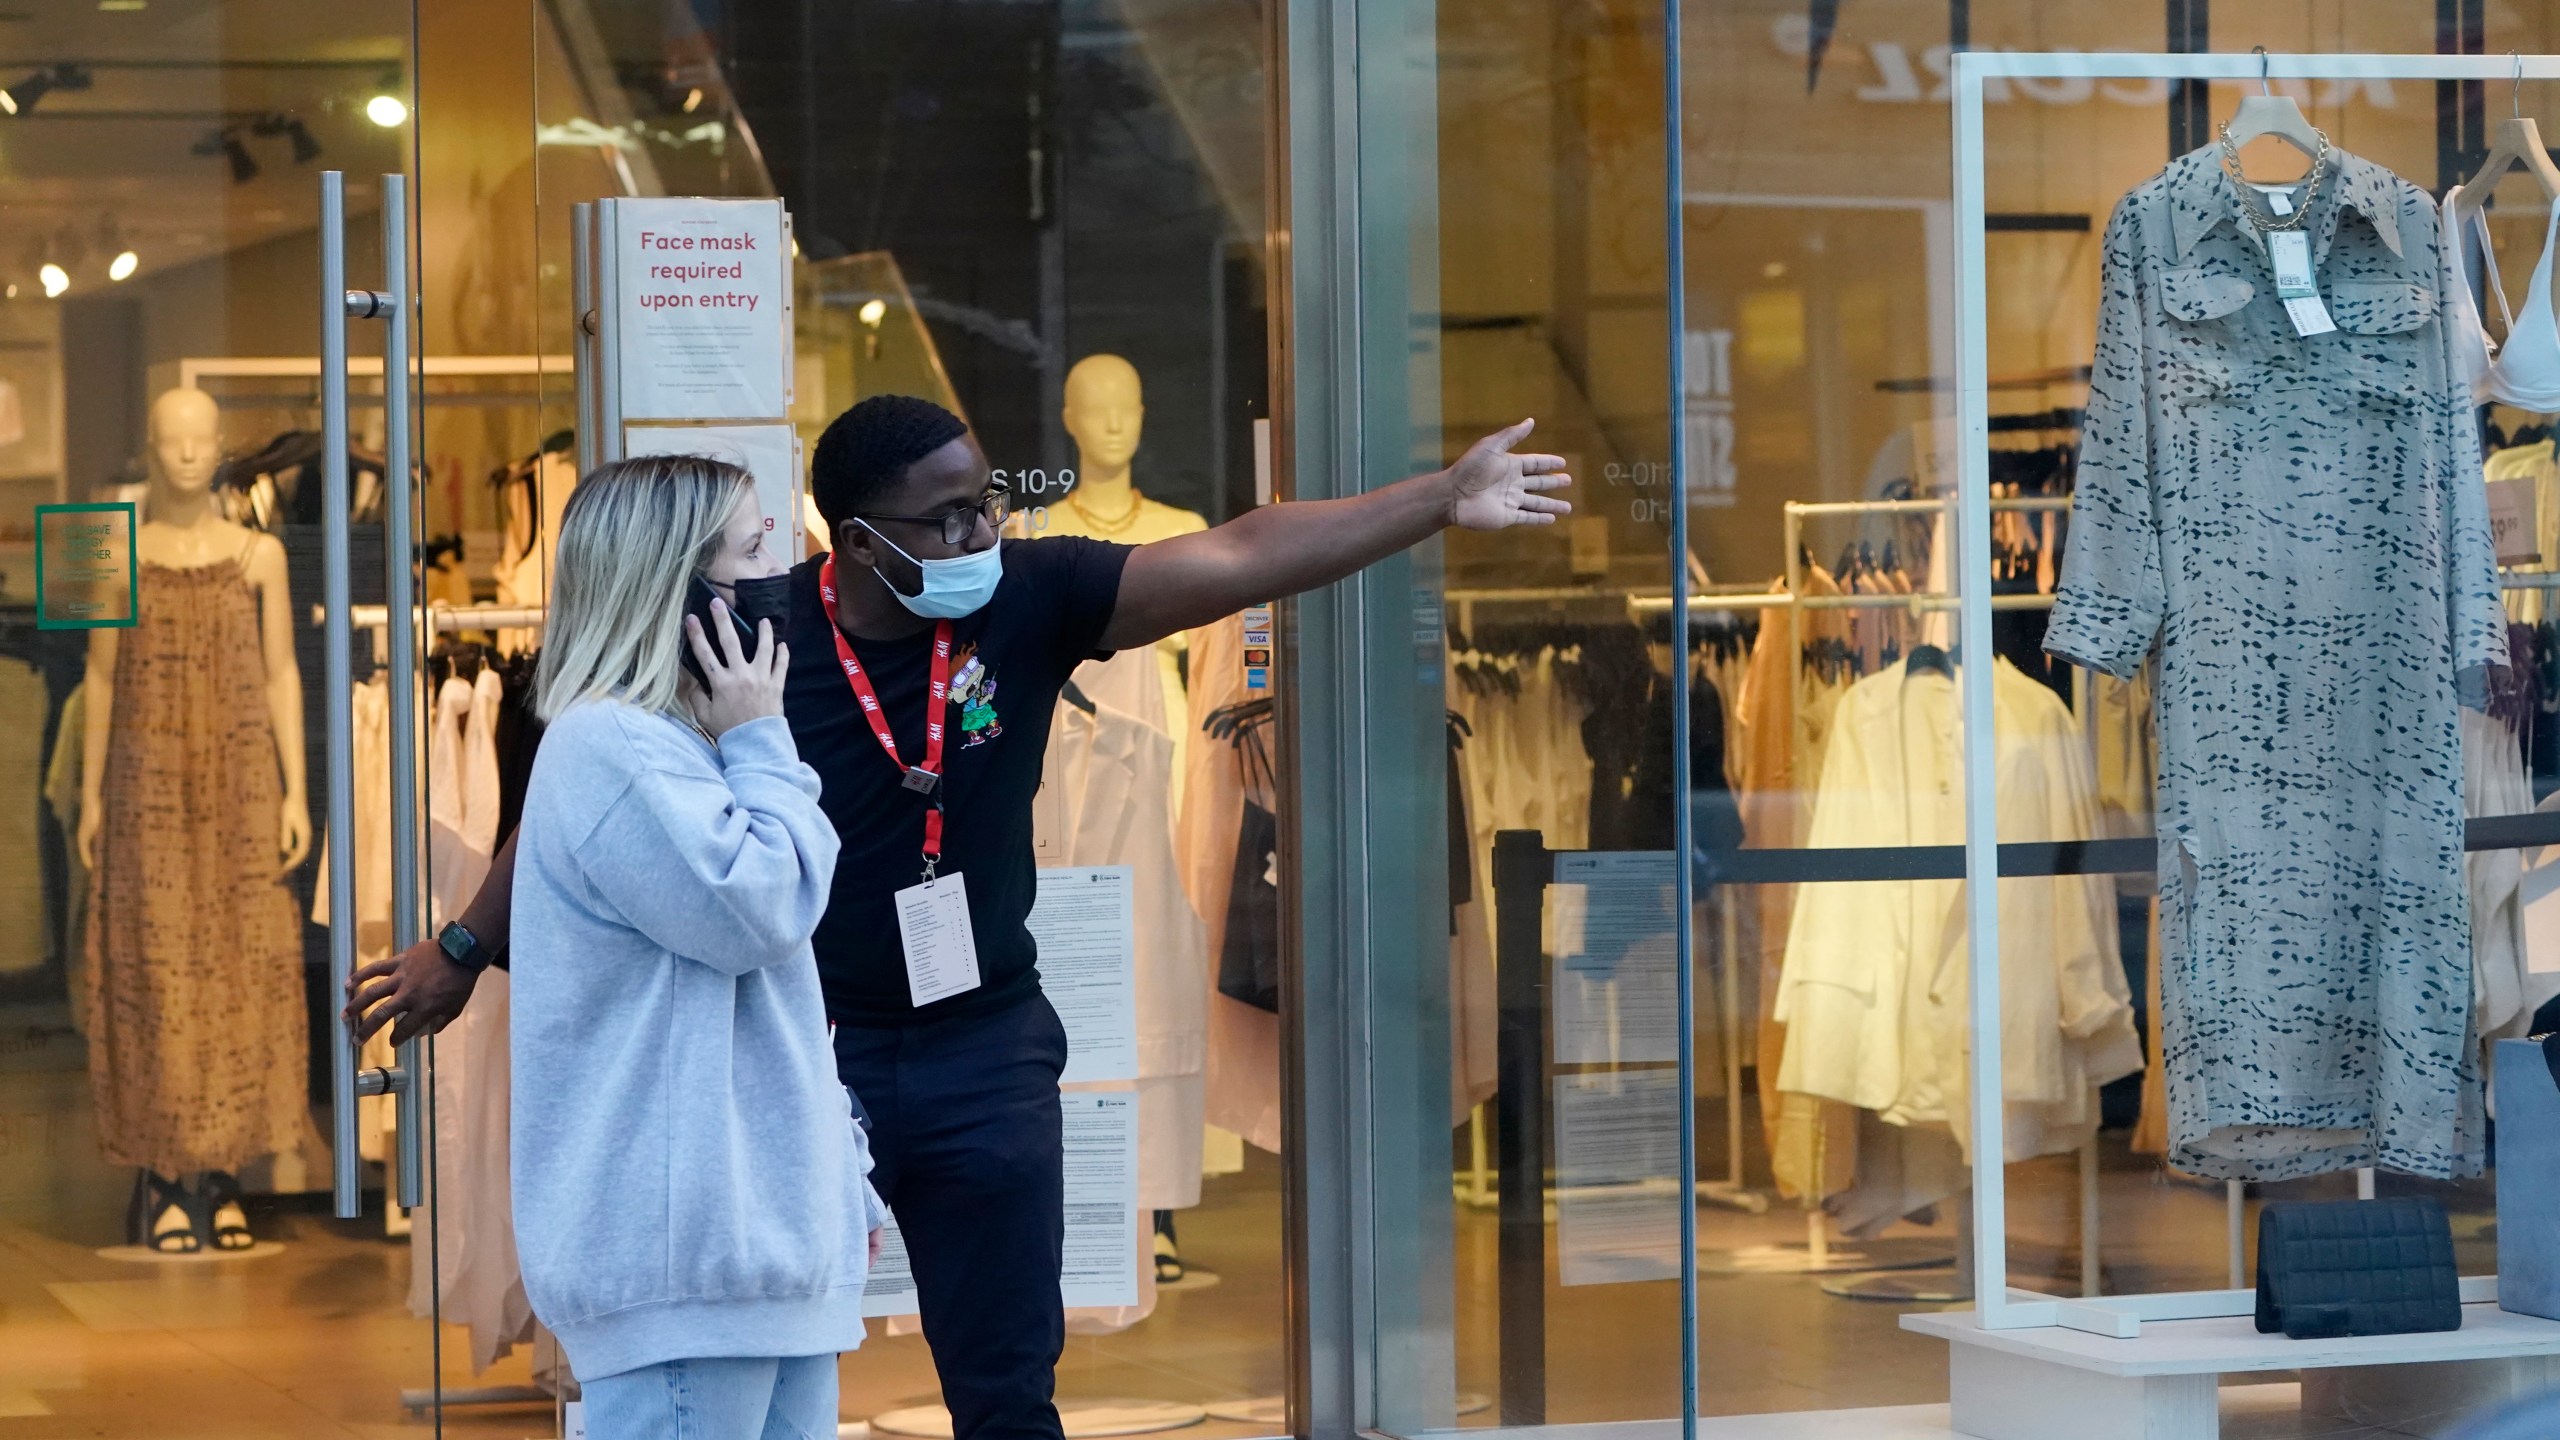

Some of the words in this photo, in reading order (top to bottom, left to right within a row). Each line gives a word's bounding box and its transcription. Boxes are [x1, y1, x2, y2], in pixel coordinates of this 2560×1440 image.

[641, 232, 694, 250] Face
[700, 232, 757, 250] mask
[651, 261, 742, 283] required
[640, 294, 693, 312] upon
[699, 291, 759, 312] entry
[1016, 468, 1075, 494] 10-9
[1248, 635, 1267, 643] VISA
